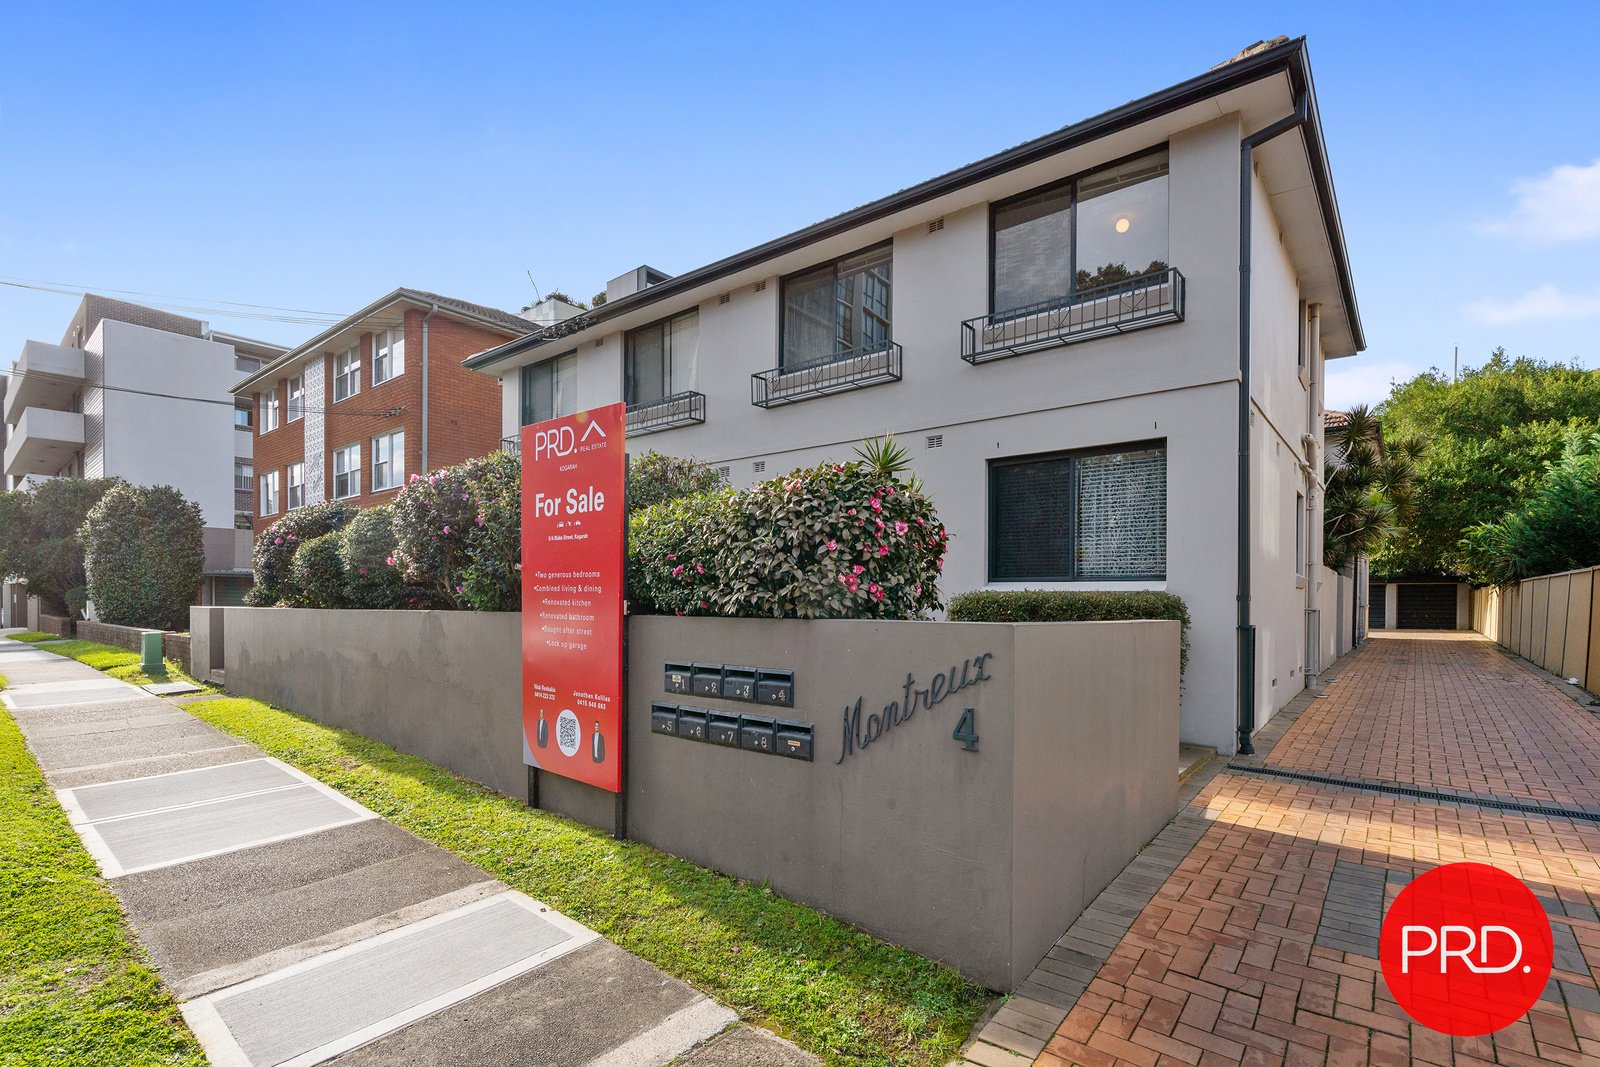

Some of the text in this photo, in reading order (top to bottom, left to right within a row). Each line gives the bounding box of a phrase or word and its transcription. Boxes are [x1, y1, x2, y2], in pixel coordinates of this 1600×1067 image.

[535, 426, 577, 461] PRD.
[591, 441, 607, 450] ESTATE
[560, 464, 578, 472] KOGARAH
[535, 486, 605, 518] For Sale
[548, 572, 572, 580] generous
[562, 584, 576, 594] living
[583, 584, 602, 594] dining
[572, 599, 591, 607] kitchen
[569, 612, 594, 621] bathroom
[563, 626, 575, 635] after
[576, 628, 592, 636] street
[561, 642, 568, 650] up
[569, 642, 587, 651] garage
[573, 690, 593, 699] Jonathan
[681, 678, 685, 689] 1
[711, 682, 717, 693] 2
[743, 685, 750, 697] 3
[778, 690, 786, 701] 4
[833, 652, 994, 766] Montreux
[952, 706, 979, 752] 4
[666, 721, 767, 748] 5 6 7 8
